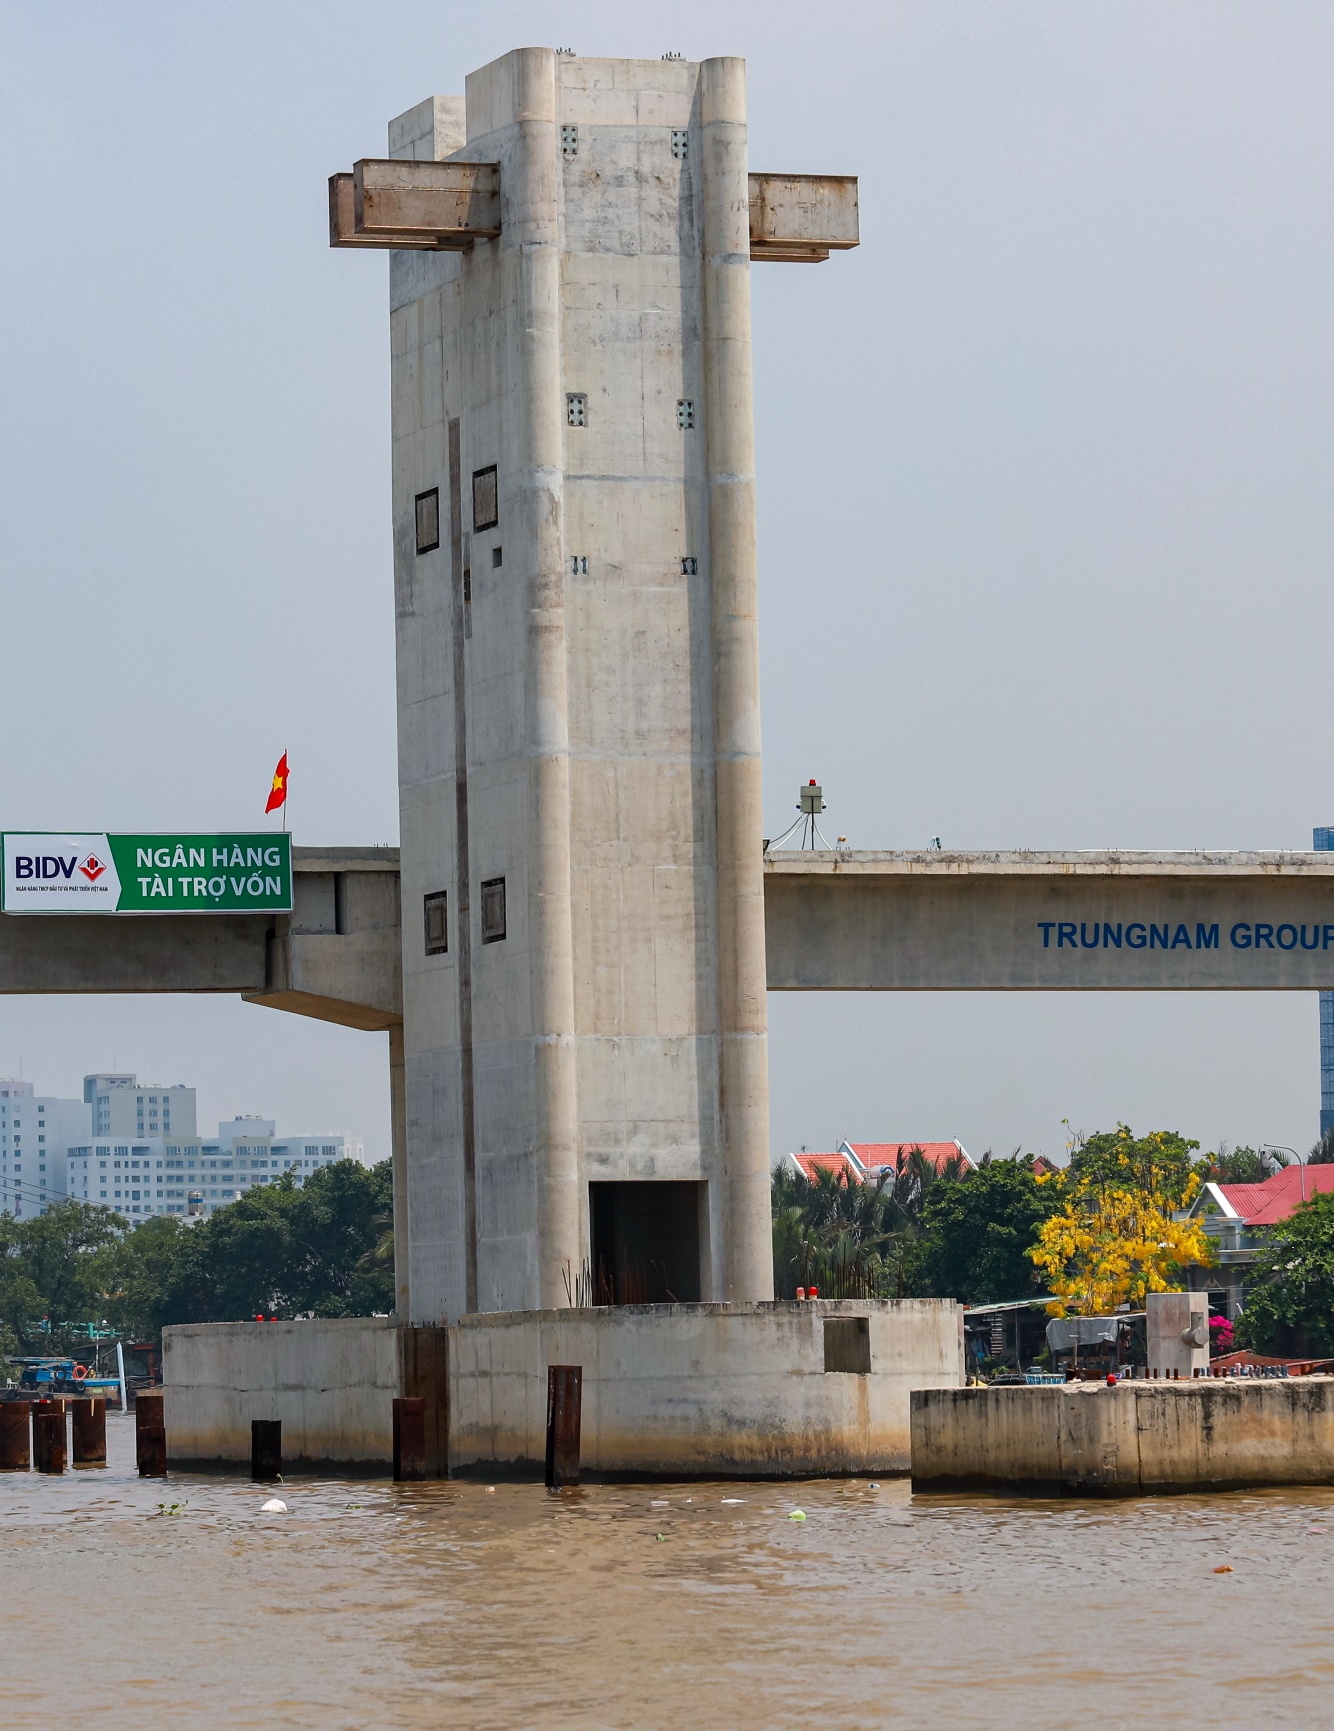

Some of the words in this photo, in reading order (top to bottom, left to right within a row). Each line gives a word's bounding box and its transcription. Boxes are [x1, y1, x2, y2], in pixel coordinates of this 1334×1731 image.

[15, 856, 77, 879] BIDV
[136, 844, 204, 867] NGÂN
[213, 843, 280, 867] HÀNG
[137, 873, 173, 896] TÀI
[182, 874, 227, 901] TRỢ
[230, 870, 281, 896] VỐN
[1037, 923, 1219, 949] TRUNGNAM
